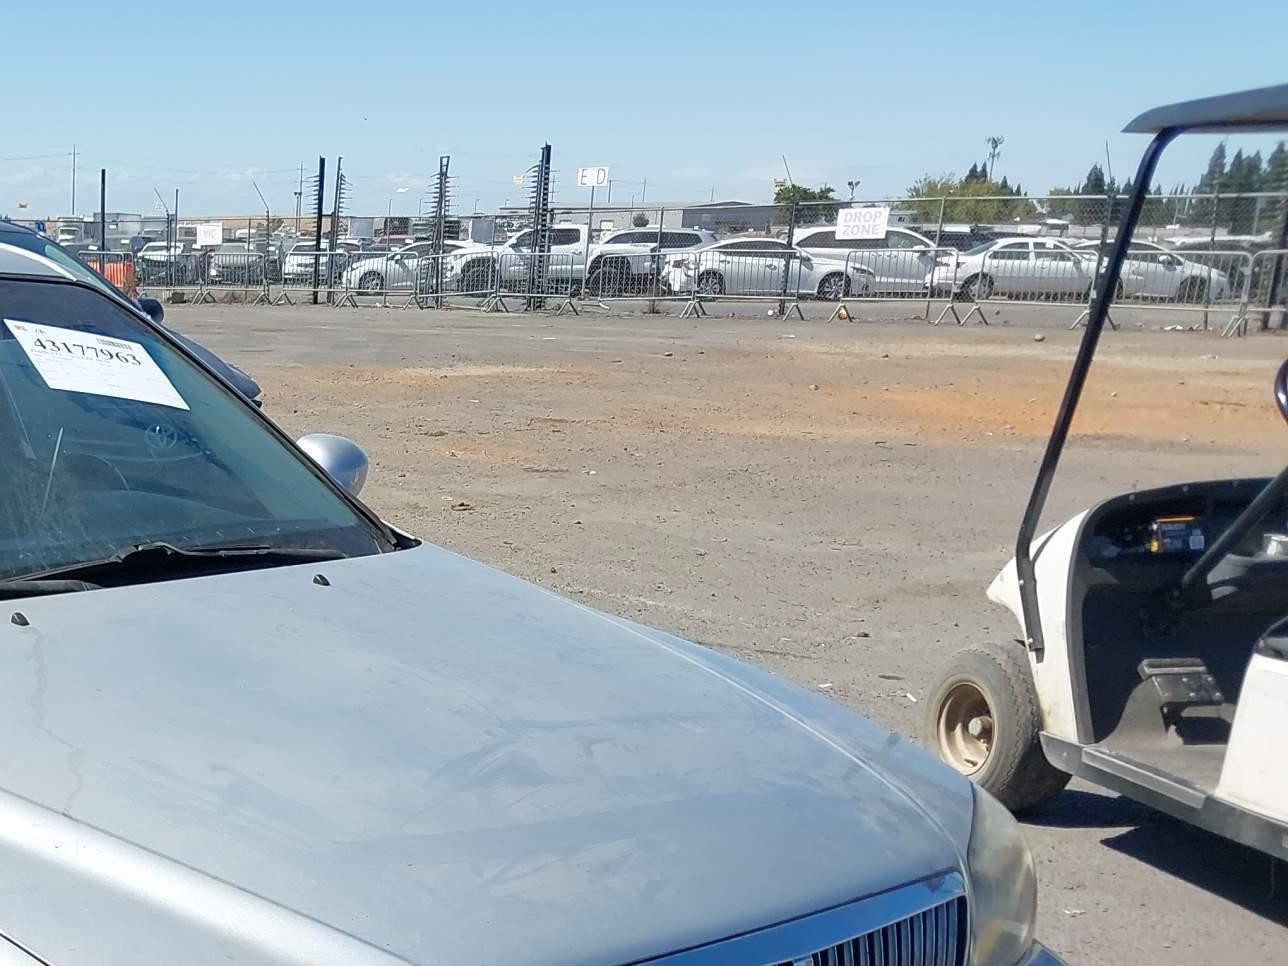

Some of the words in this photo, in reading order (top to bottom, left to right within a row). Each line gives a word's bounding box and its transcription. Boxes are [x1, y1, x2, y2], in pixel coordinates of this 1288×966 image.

[580, 168, 589, 186] E
[596, 167, 606, 185] D
[843, 210, 883, 224] DROP
[841, 223, 881, 237] ZONE
[33, 337, 142, 366] 43177963
